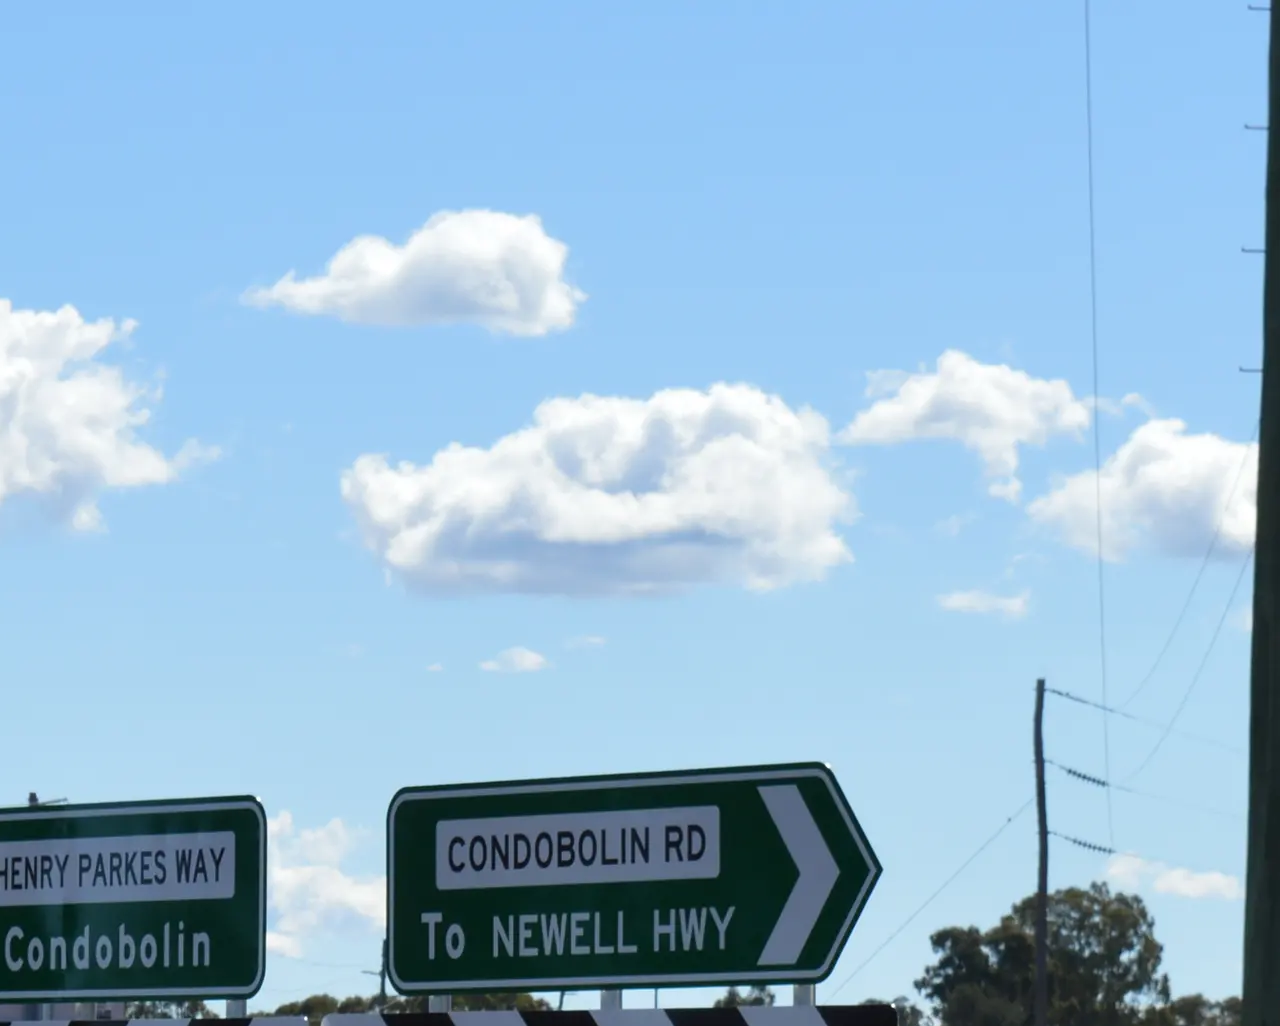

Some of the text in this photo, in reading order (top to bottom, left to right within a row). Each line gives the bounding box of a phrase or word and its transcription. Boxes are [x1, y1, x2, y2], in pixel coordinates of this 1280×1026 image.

[78, 850, 167, 888] PARKES
[175, 846, 226, 884] WAY
[448, 824, 706, 873] CONDOBOLIN RD
[4, 920, 210, 972] Condobolin
[420, 905, 736, 960] To NEWELL HWY
